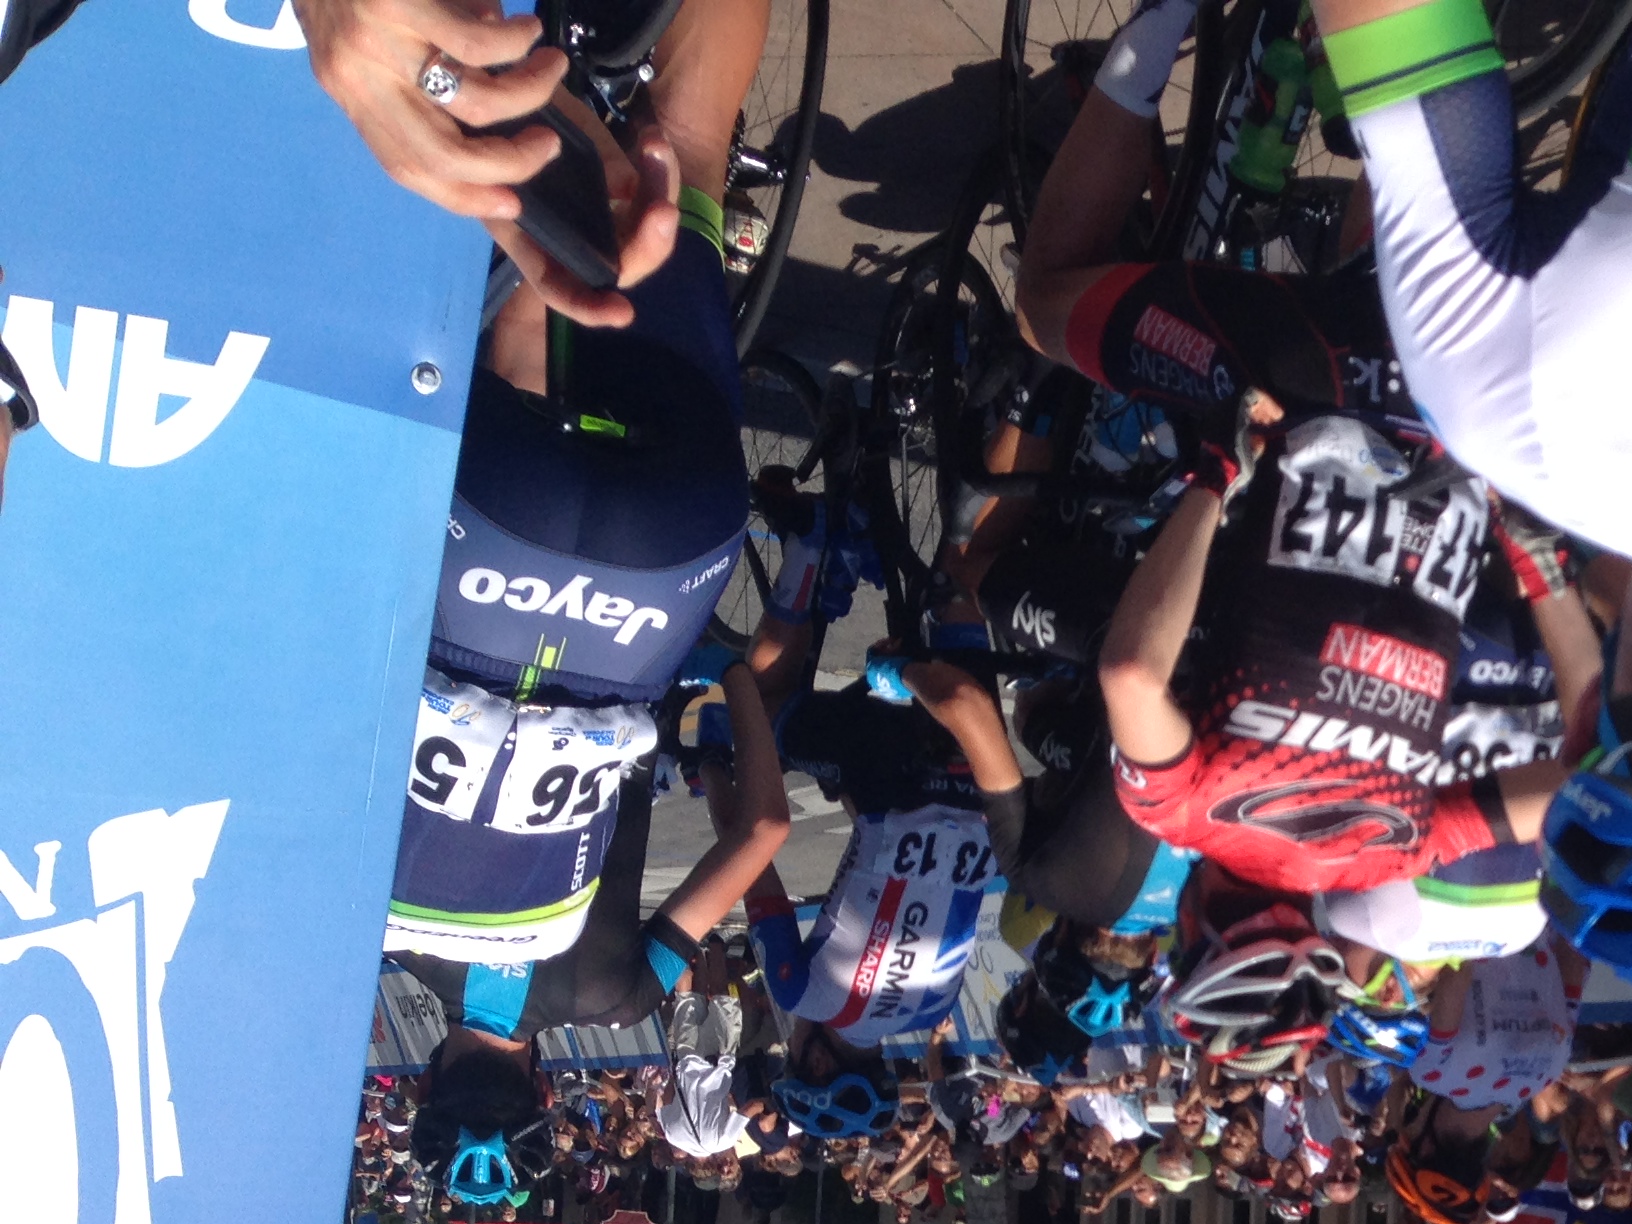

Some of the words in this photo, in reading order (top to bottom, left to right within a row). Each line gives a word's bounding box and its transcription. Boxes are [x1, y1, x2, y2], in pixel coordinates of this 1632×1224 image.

[1280, 472, 1395, 567] 147
[458, 566, 669, 645] Jayco
[691, 556, 730, 590] CRAFT
[1325, 623, 1445, 697] BERMAN
[1315, 664, 1437, 732] HAGENS
[525, 760, 622, 826] 56
[570, 832, 590, 891] SCOTT
[892, 831, 937, 878] 13
[952, 840, 992, 886] 13
[857, 918, 889, 997] SHARP
[869, 901, 928, 1020] GARMIN
[395, 992, 440, 1026] belkin
